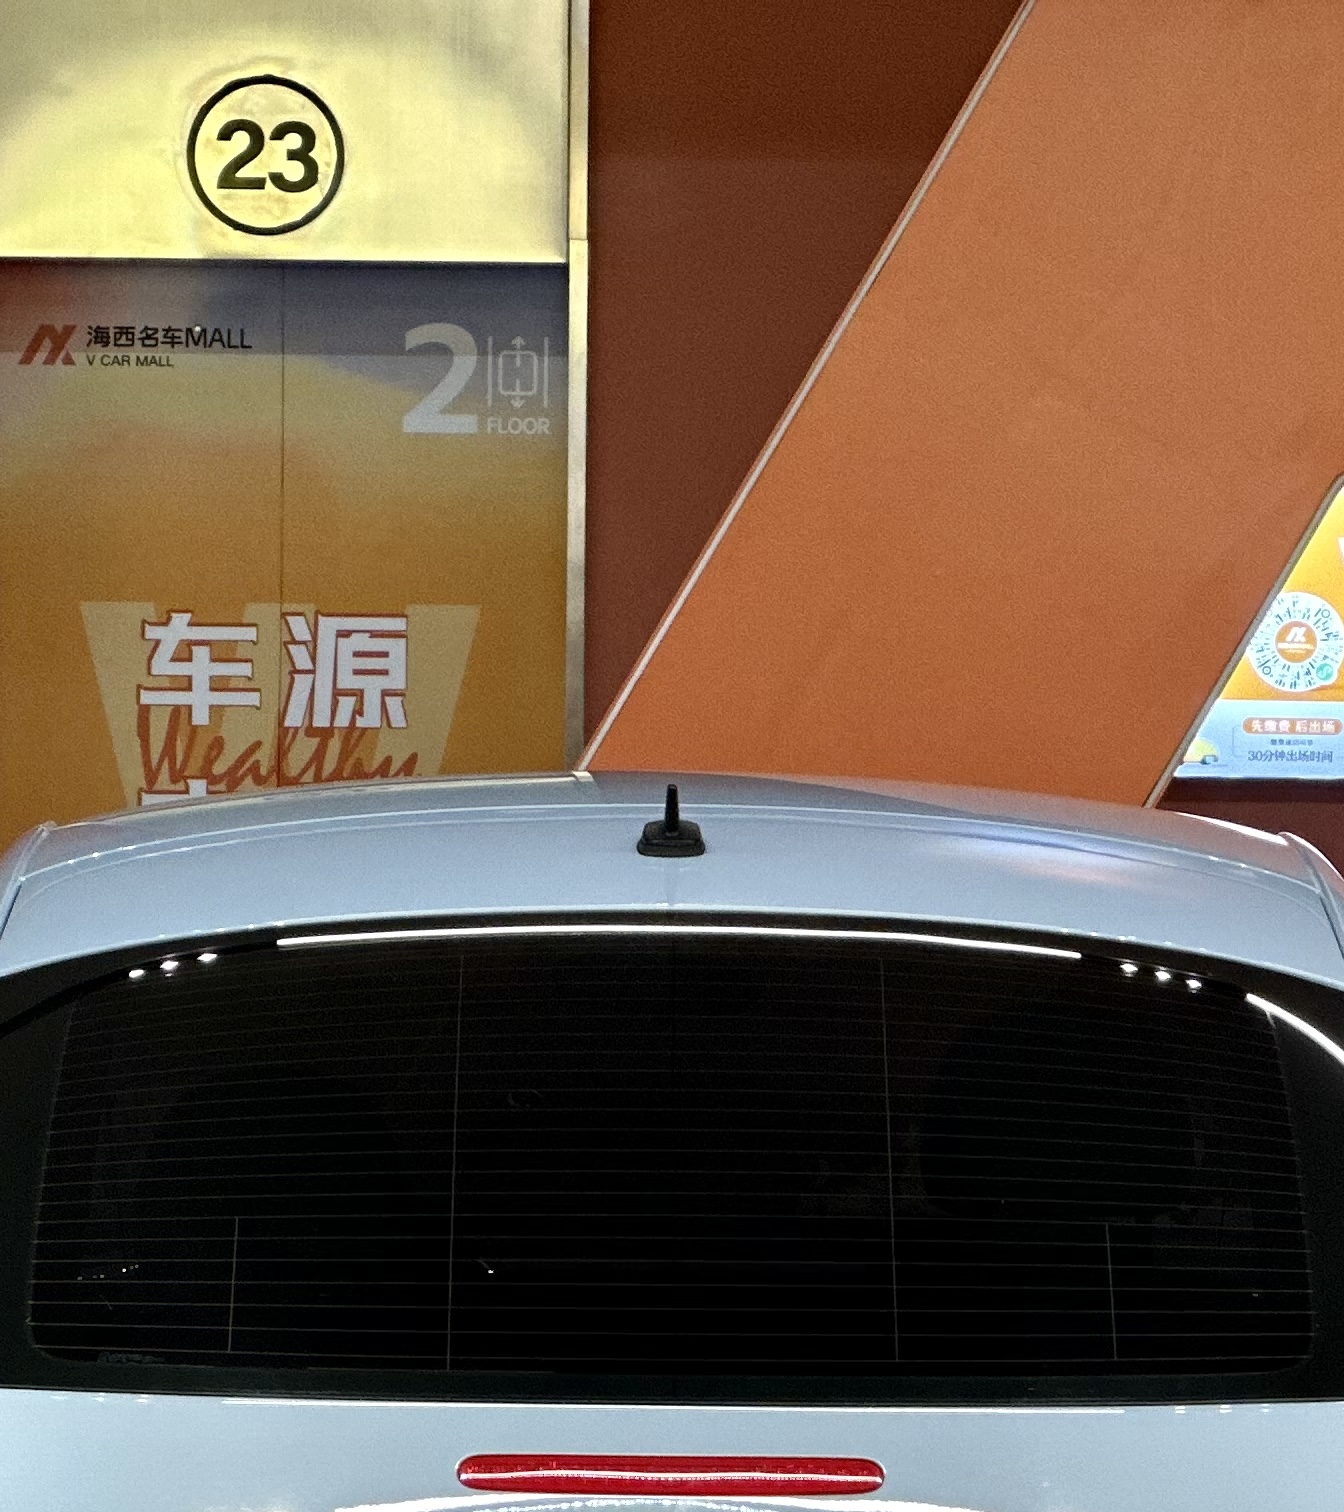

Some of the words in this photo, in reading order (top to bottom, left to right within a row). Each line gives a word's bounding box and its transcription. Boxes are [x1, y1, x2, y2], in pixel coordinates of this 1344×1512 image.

[216, 119, 320, 193] 23
[86, 325, 254, 349] 海西名车MALL
[86, 355, 96, 367] V
[100, 355, 131, 367] CAR
[135, 355, 175, 368] MALL
[402, 323, 479, 434] 2
[487, 417, 551, 435] FLOOR
[139, 610, 409, 729] 车源
